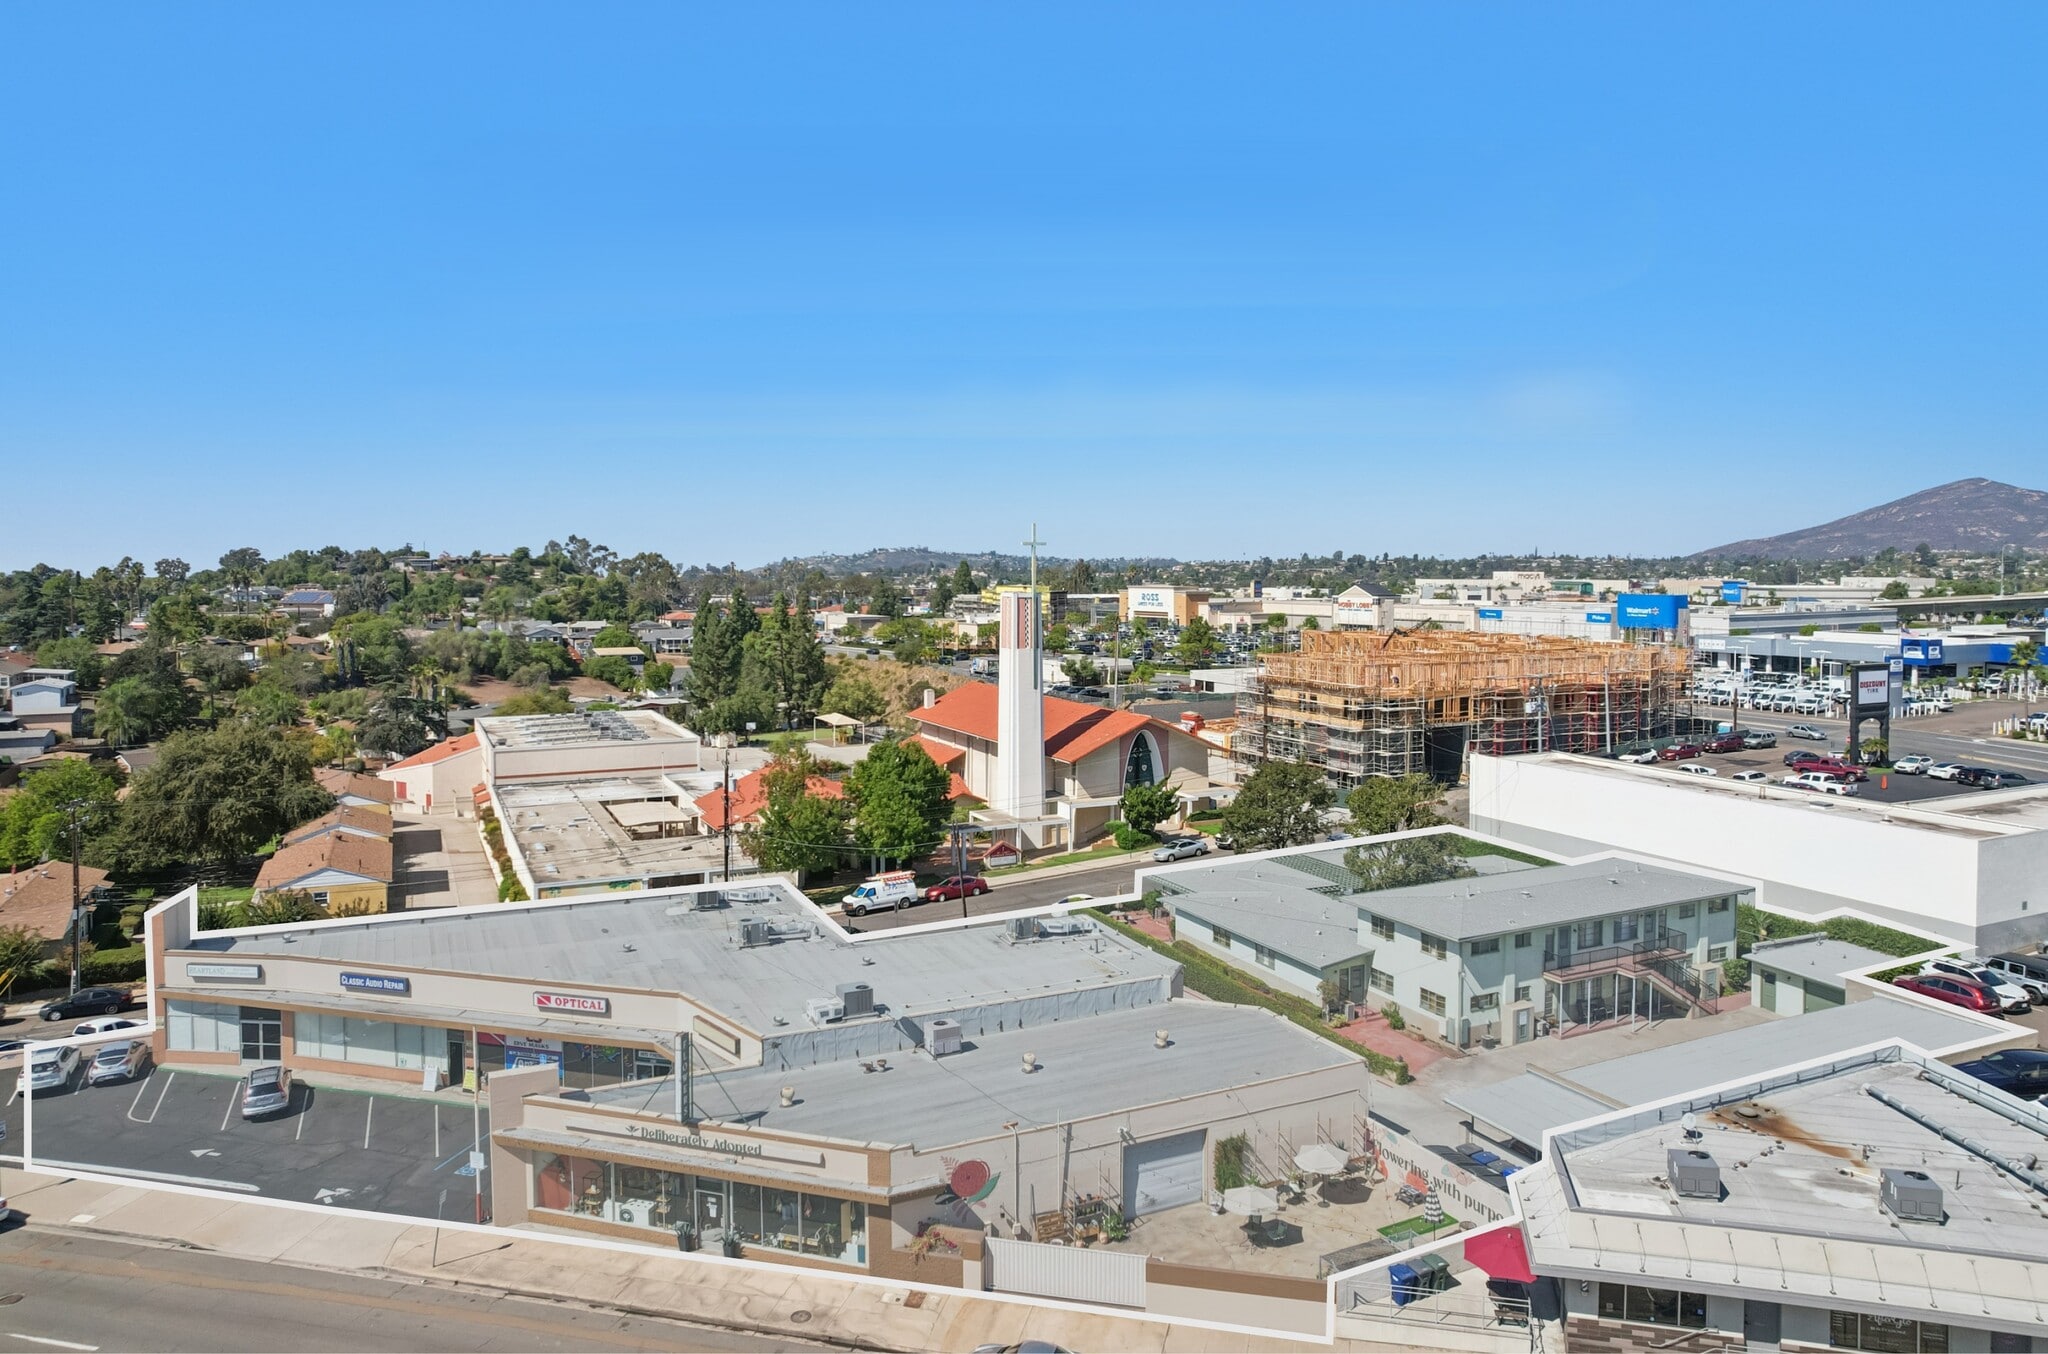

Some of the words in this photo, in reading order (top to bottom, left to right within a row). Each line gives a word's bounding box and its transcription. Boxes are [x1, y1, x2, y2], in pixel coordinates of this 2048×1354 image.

[1141, 593, 1159, 601] ROSS
[1860, 680, 1886, 689] DISCOUNT
[555, 997, 604, 1011] OPTICAL
[641, 1126, 709, 1147] Deliberately
[712, 1138, 762, 1156] Adopted
[1432, 1176, 1461, 1202] with
